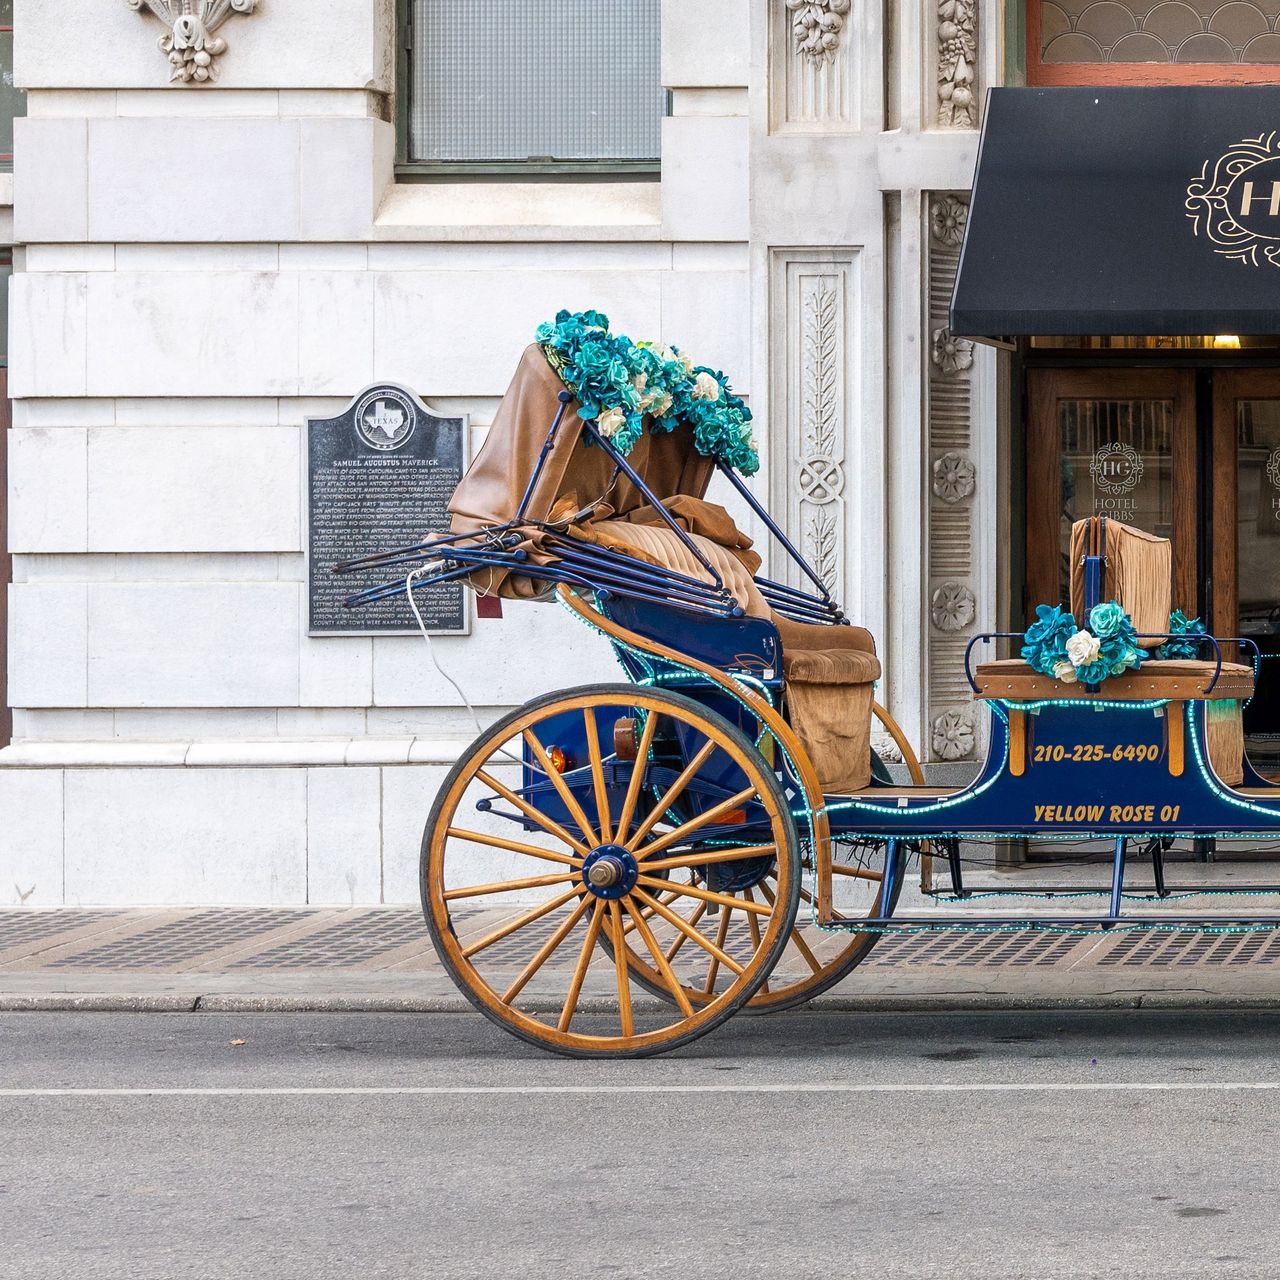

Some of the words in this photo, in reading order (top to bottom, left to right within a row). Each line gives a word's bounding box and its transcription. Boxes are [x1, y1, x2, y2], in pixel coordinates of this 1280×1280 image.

[1103, 461, 1131, 476] HG
[1095, 499, 1138, 509] HOTEL
[1098, 510, 1134, 520] GIBBS
[1034, 744, 1159, 762] 210-225-6490
[1034, 805, 1105, 822] YELLOW
[1109, 805, 1155, 822] ROSE
[1160, 805, 1180, 822] 01
